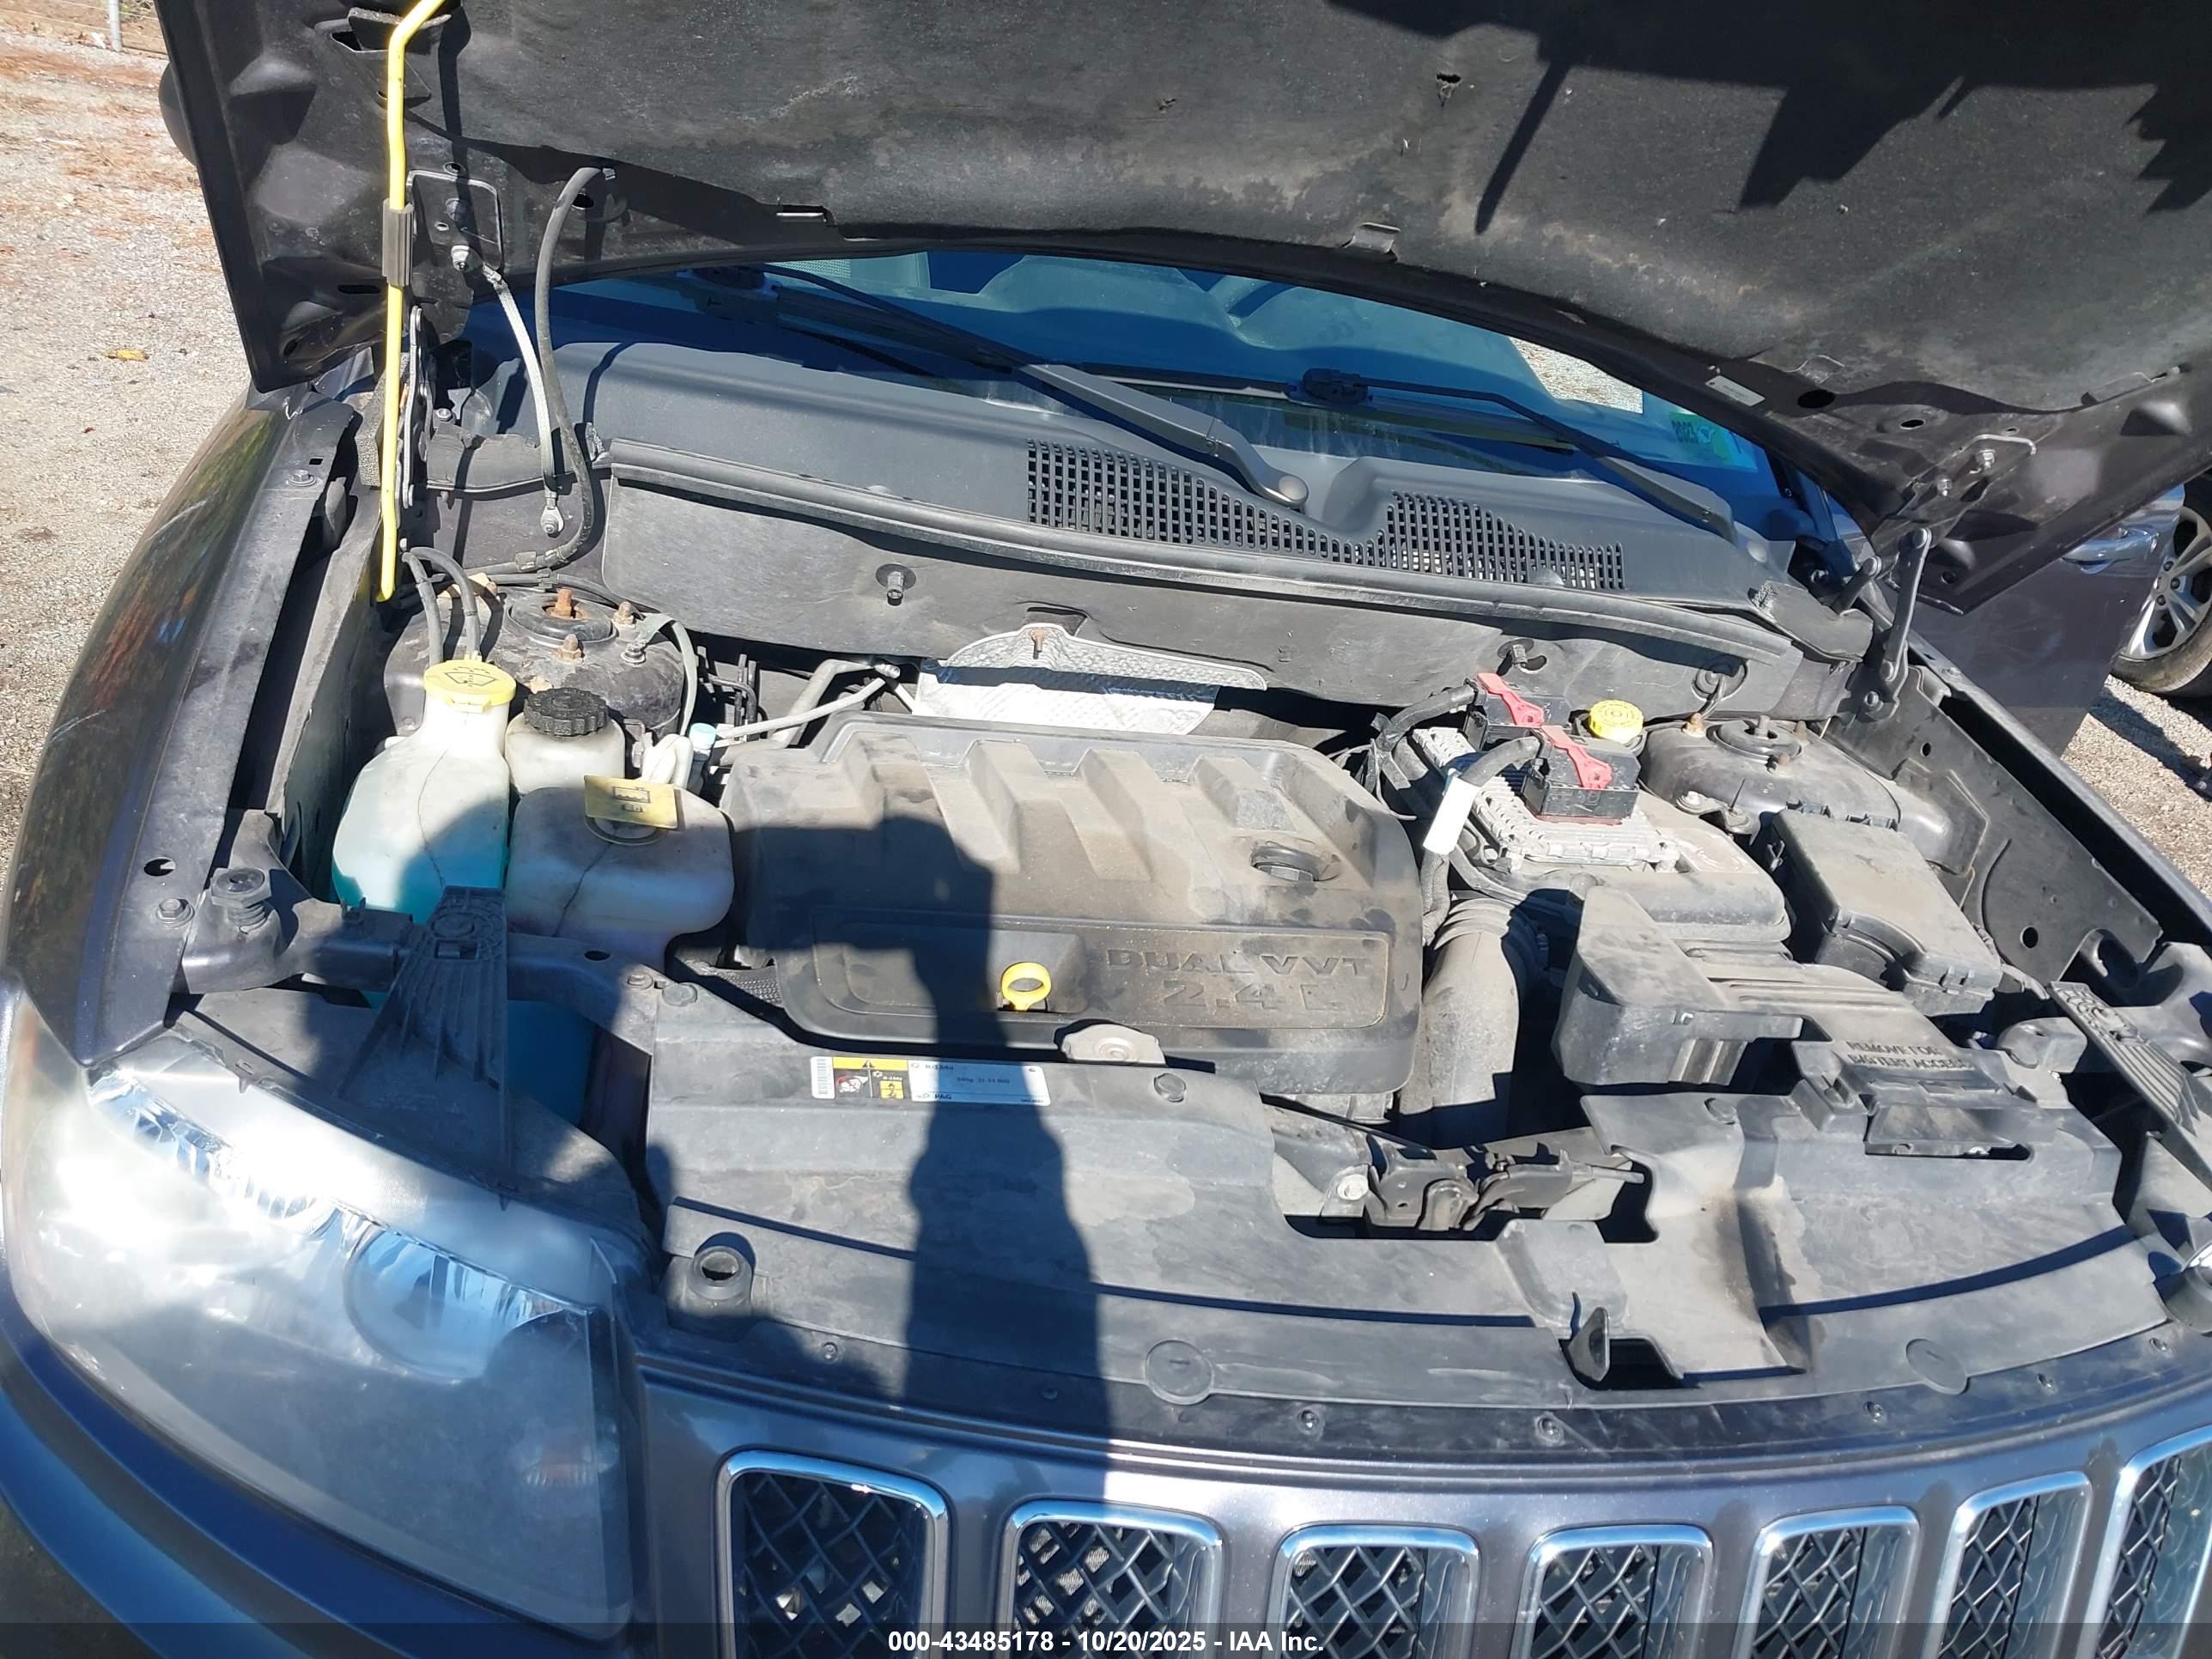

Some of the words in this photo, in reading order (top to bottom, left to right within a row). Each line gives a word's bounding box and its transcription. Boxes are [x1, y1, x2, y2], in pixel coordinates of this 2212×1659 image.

[1105, 947, 1255, 975] DUAL
[1260, 954, 1374, 976] VVT
[1163, 980, 1287, 1011] 2.4
[1845, 1041, 1908, 1055] REMOVE
[1909, 1045, 1942, 1057] FOR
[1847, 1054, 1911, 1067] BATTERY
[1913, 1059, 1975, 1070] ACCESS
